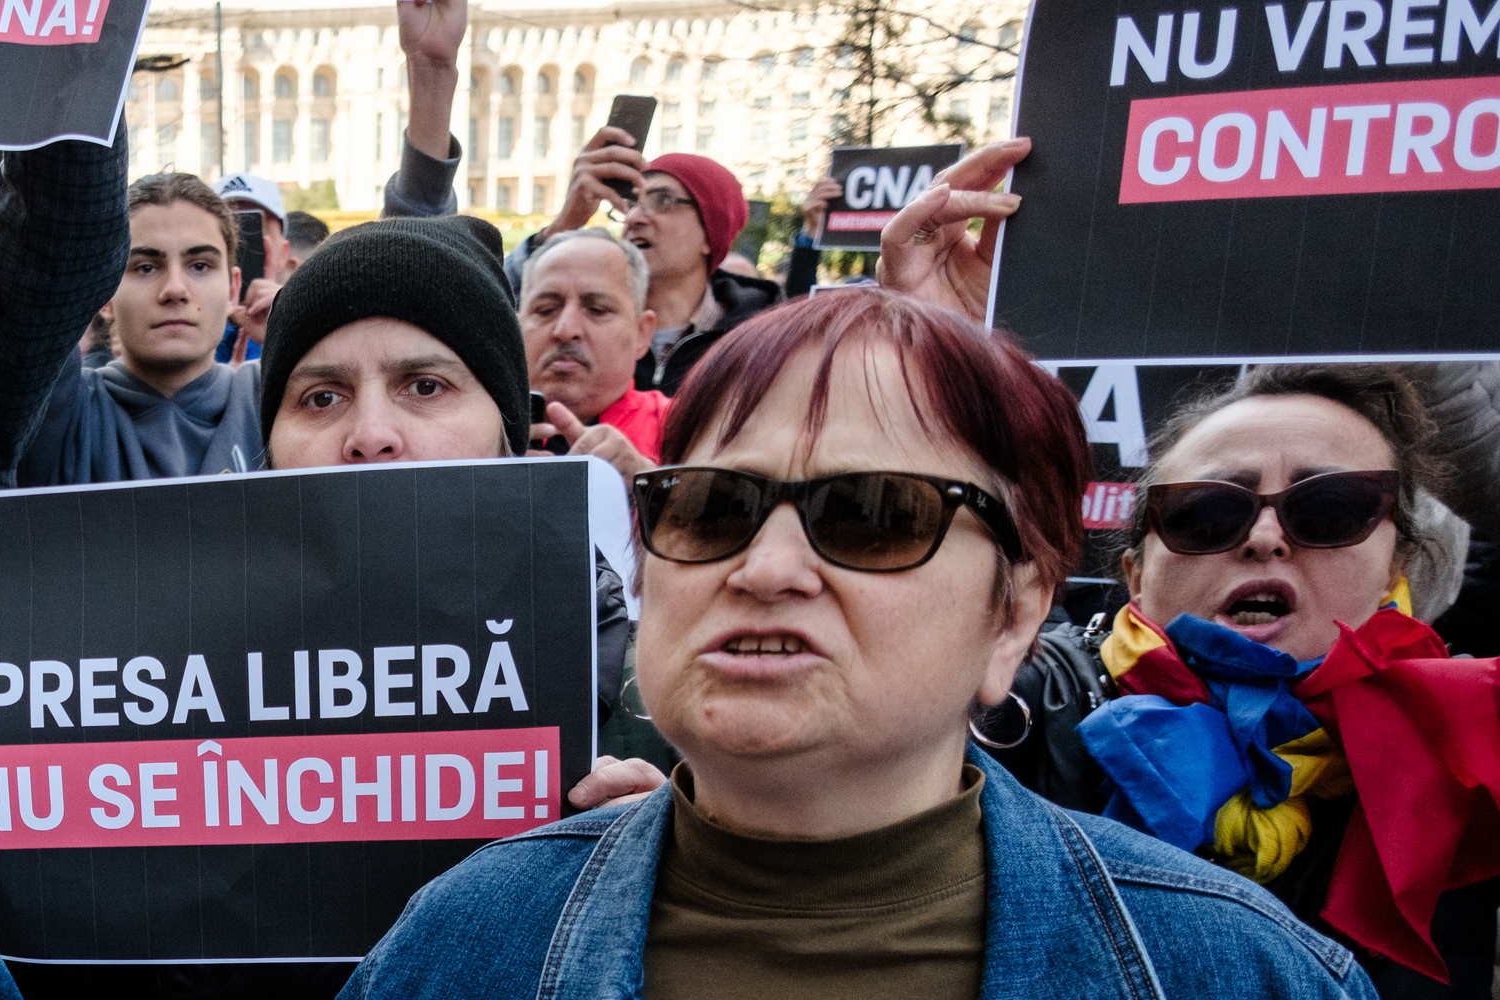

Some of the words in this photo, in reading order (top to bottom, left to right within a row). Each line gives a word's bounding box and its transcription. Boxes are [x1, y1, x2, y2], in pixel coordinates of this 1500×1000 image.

[1109, 9, 1237, 87] NU
[1265, 0, 1500, 72] VREM
[1137, 98, 1500, 186] CONTRO
[248, 618, 529, 722] LIBERĂ
[89, 761, 181, 829] SE
[197, 739, 549, 827] ÎNCHIDE!
